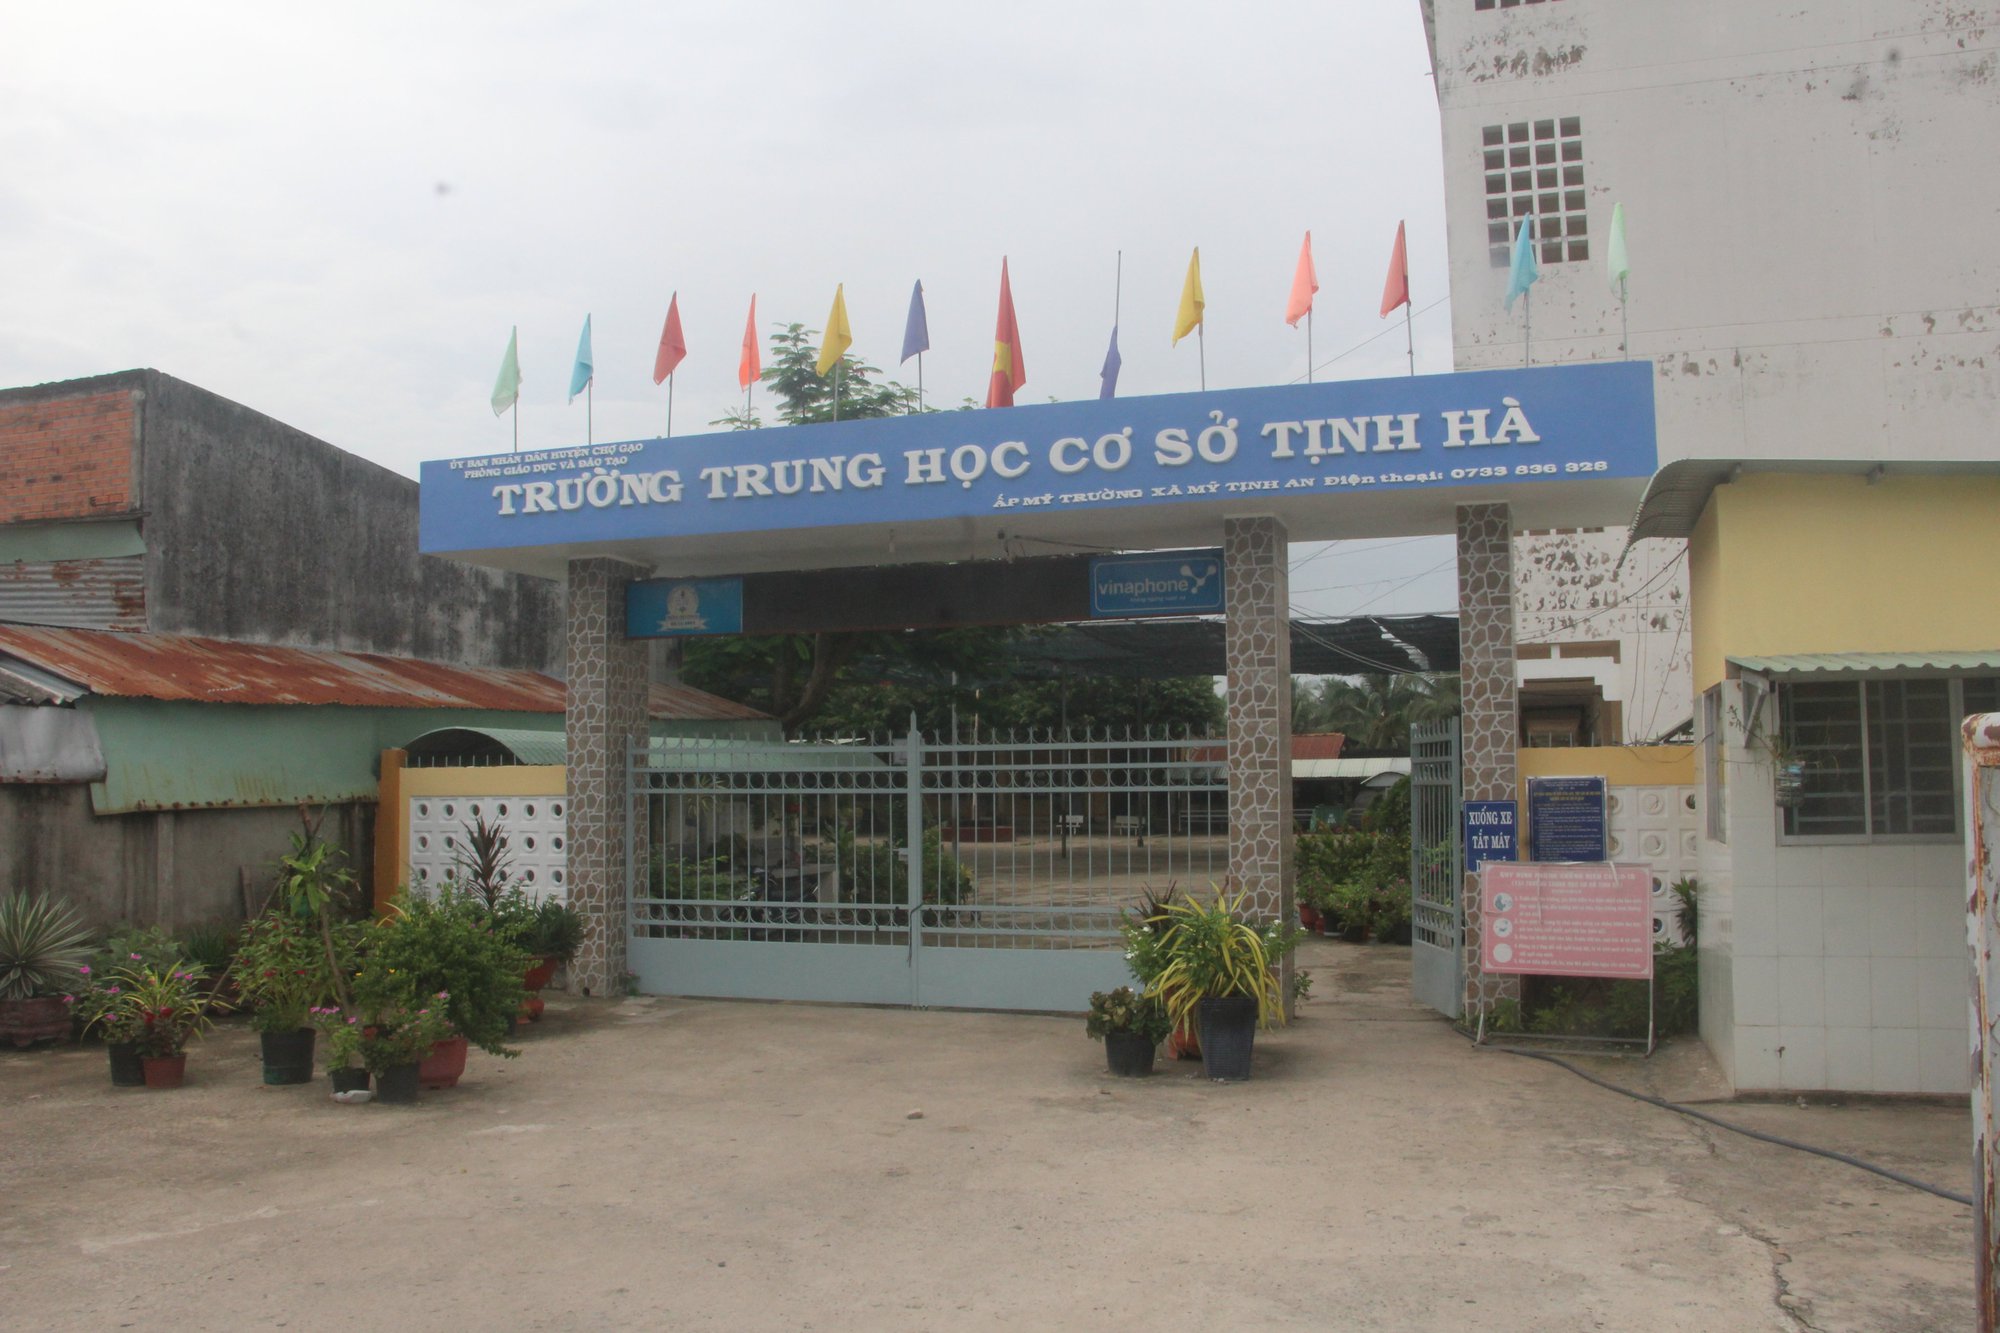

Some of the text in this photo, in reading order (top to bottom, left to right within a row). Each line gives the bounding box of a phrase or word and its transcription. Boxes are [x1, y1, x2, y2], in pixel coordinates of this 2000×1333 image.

[467, 458, 489, 469] BAN
[491, 455, 522, 466] NHÂN
[525, 452, 549, 463] DÂN
[592, 444, 618, 456] CHỢ
[619, 443, 644, 454] GẠO
[492, 397, 1541, 517] TRƯỜNG TRUNG HỌC CƠ SỞ TỊNH HÀ
[503, 464, 531, 475] GIÁO
[533, 462, 558, 474] DỤC
[560, 459, 576, 470] VÀ
[604, 456, 628, 467] TẠO
[1058, 487, 1143, 504] TRƯỜNG
[1225, 478, 1281, 494] TỊNH
[1284, 477, 1317, 489] AN
[1323, 474, 1377, 488] Điện
[1451, 466, 1508, 480] 0733
[1098, 578, 1189, 596] vinaphone
[1469, 805, 1513, 825] XUỐNG XE
[1472, 829, 1511, 849] TẮT MÁY
